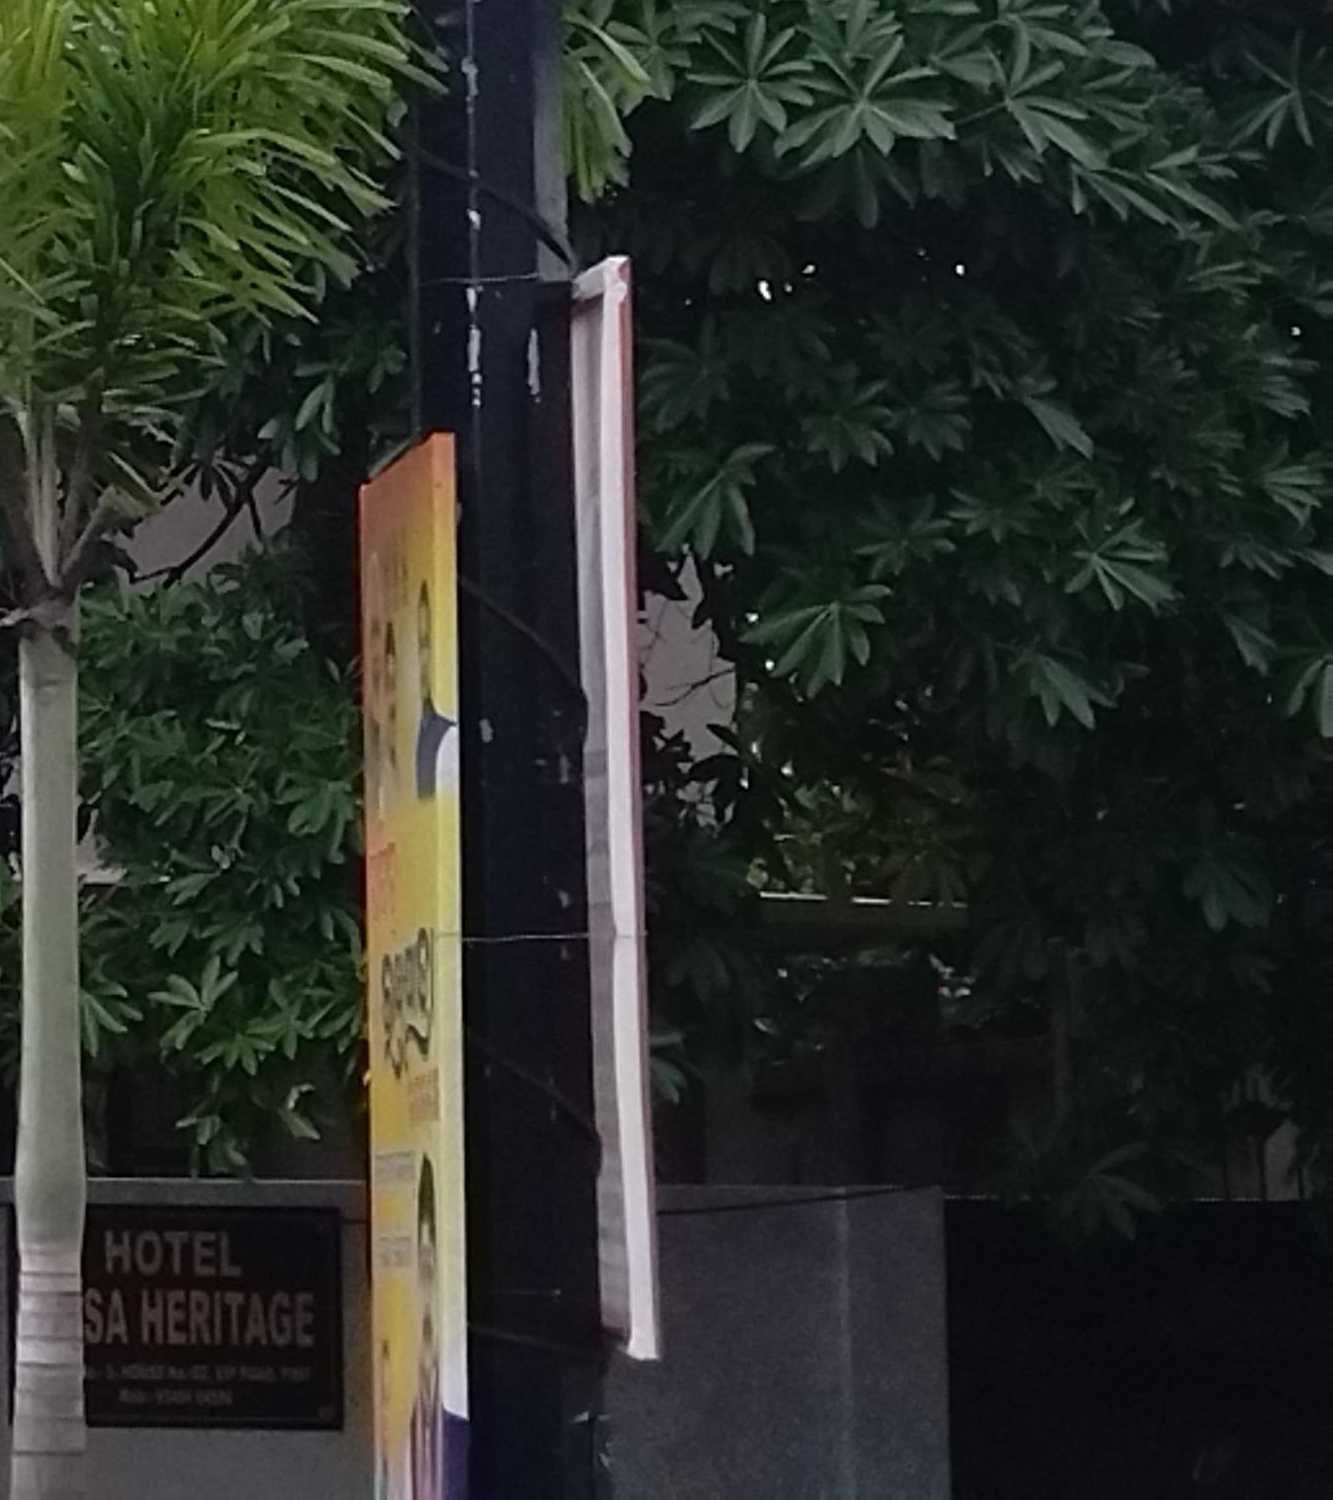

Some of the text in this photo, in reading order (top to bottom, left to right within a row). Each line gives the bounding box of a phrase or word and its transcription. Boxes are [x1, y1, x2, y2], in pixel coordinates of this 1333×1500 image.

[104, 1229, 243, 1277] HOTEL
[83, 1287, 316, 1348] SA HERITAGE
